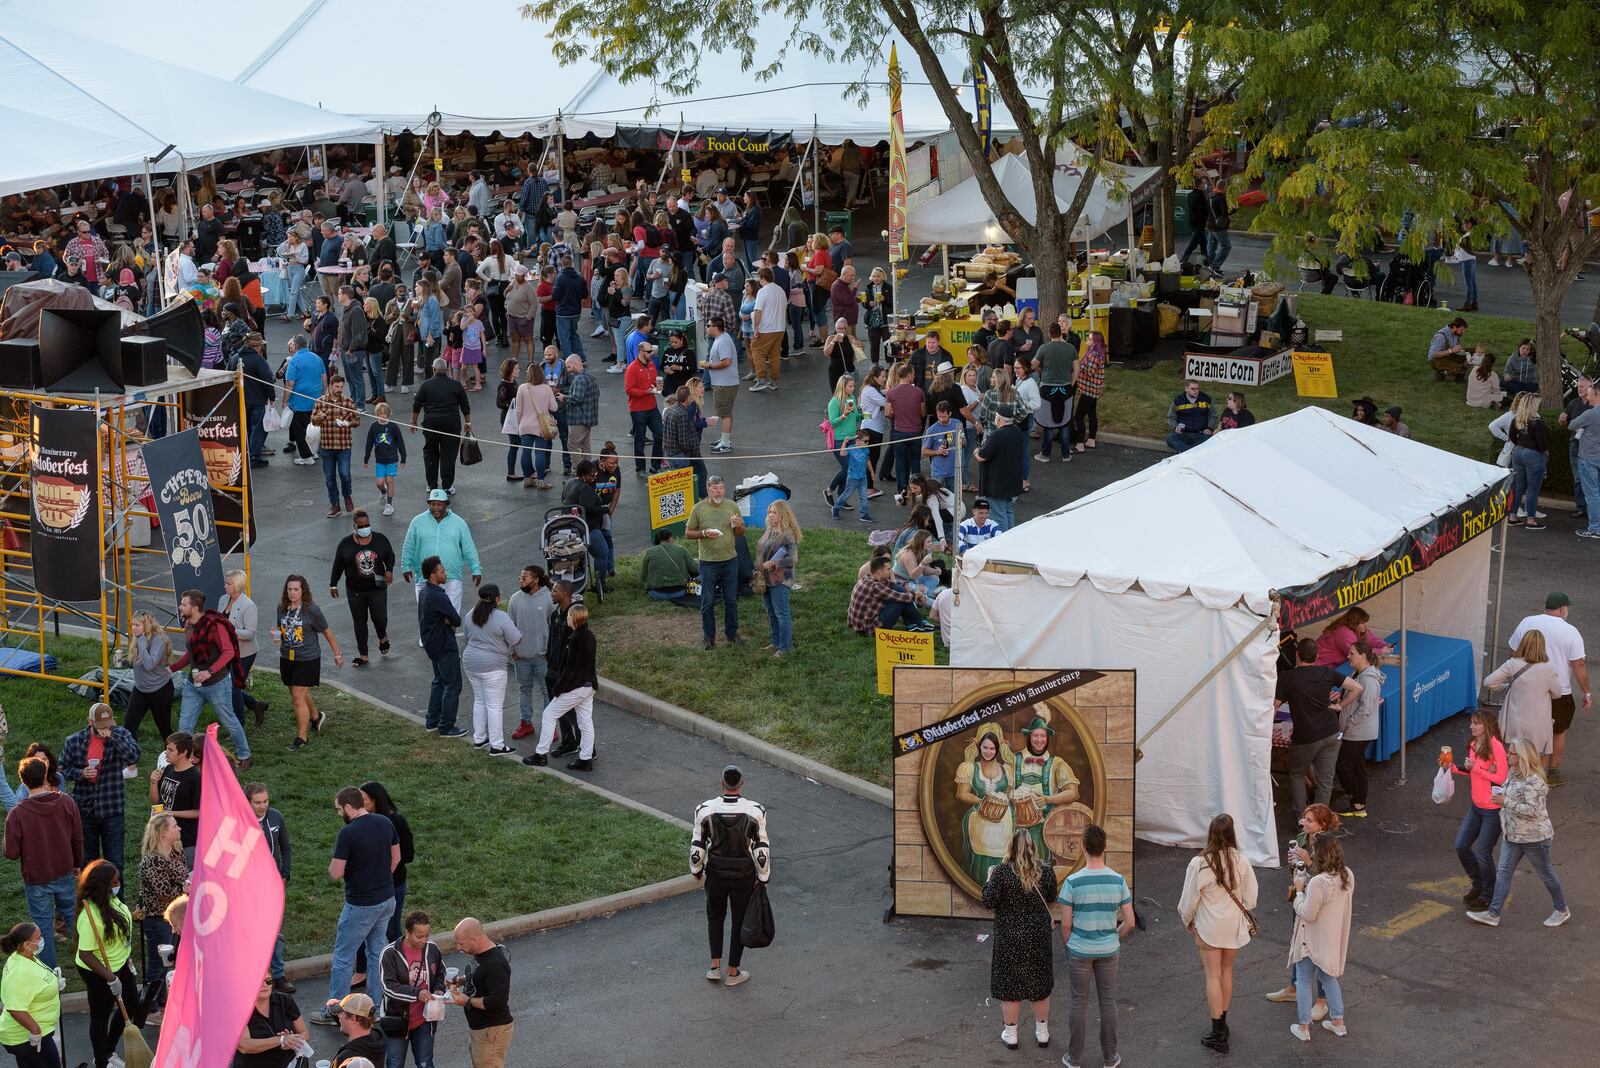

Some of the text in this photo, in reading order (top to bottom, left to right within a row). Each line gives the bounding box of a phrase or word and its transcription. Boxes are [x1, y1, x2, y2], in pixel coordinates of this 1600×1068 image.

[707, 137, 736, 151] Food
[1293, 354, 1329, 363] Oktoberfest
[1187, 358, 1254, 382] Caramel Corn
[1261, 359, 1280, 382] Kettle
[41, 446, 78, 459] Anniversary
[160, 468, 208, 504] CHEERS
[650, 471, 690, 486] Oktoberfest
[173, 503, 210, 548] 50
[1462, 508, 1487, 543] First
[878, 632, 930, 646] Oktoberfest
[897, 651, 915, 662] Lite
[922, 670, 1081, 742] Oktoberfest 2021 50th Anniversary
